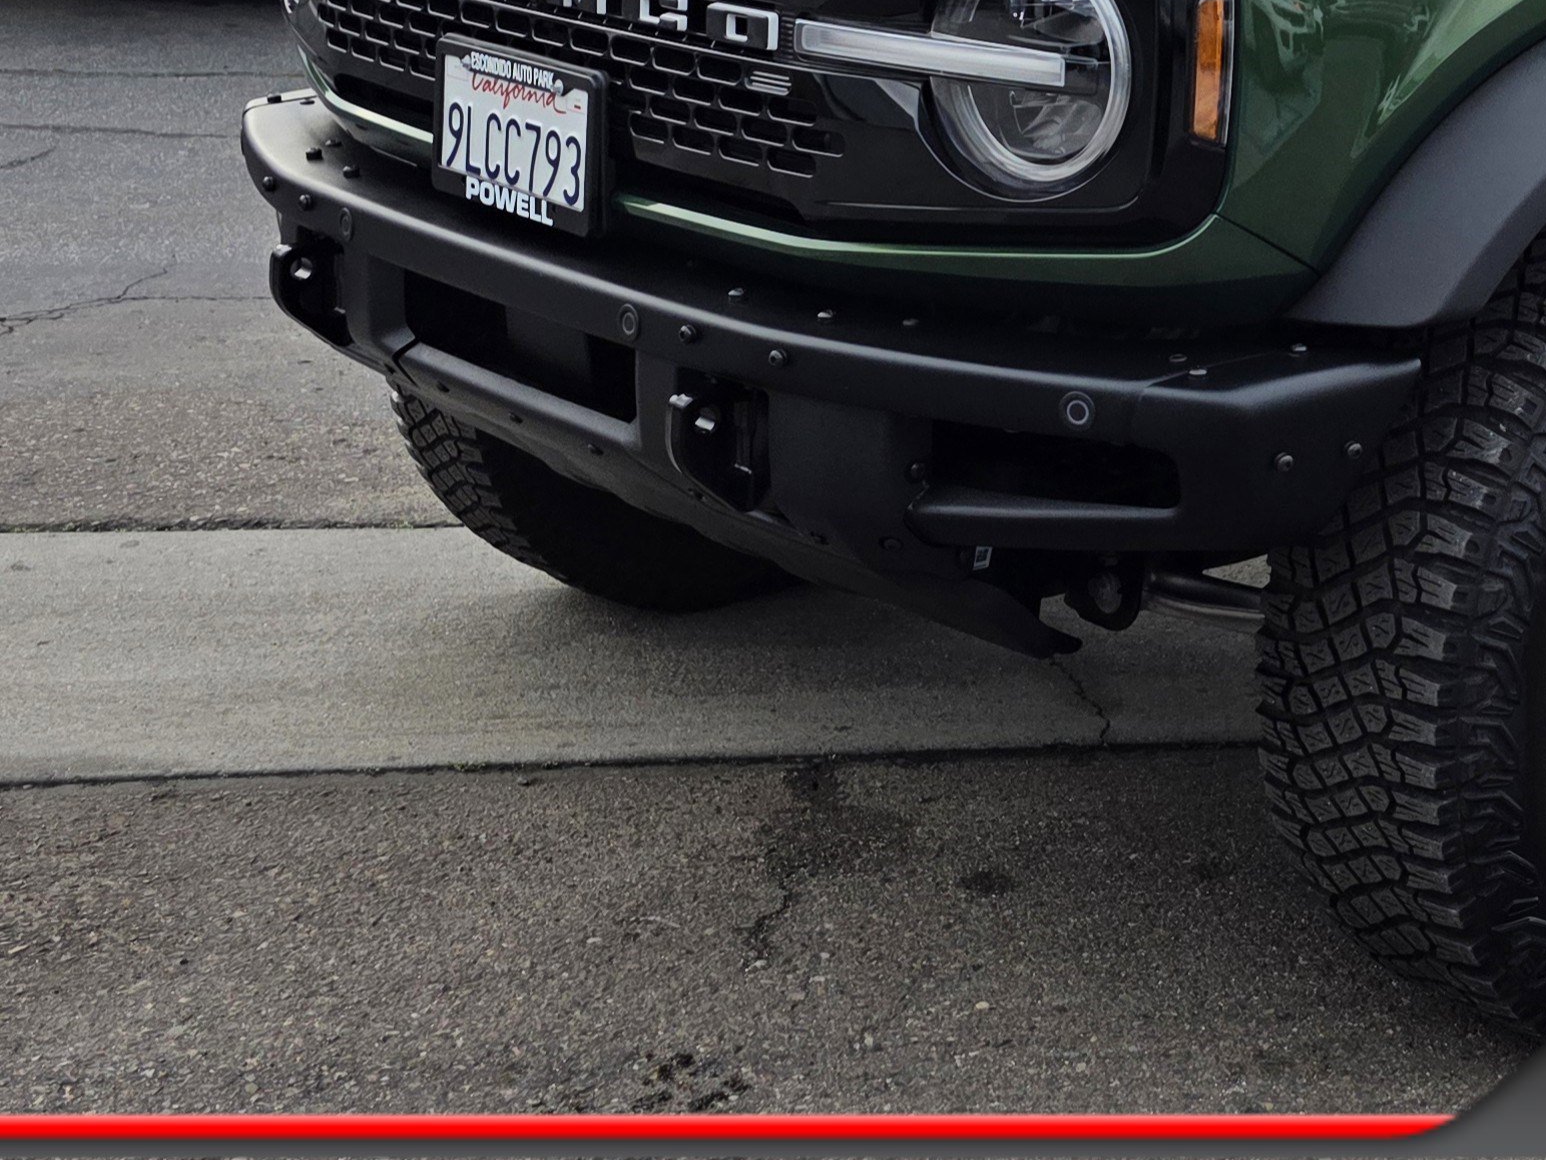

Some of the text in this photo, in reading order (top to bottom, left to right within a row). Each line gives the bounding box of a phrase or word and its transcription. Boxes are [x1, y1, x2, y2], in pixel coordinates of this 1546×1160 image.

[471, 51, 555, 90] ESCONDIDO AUTO PARK
[471, 72, 567, 115] California
[446, 101, 582, 206] 9LCC793
[466, 175, 553, 227] POWELL
